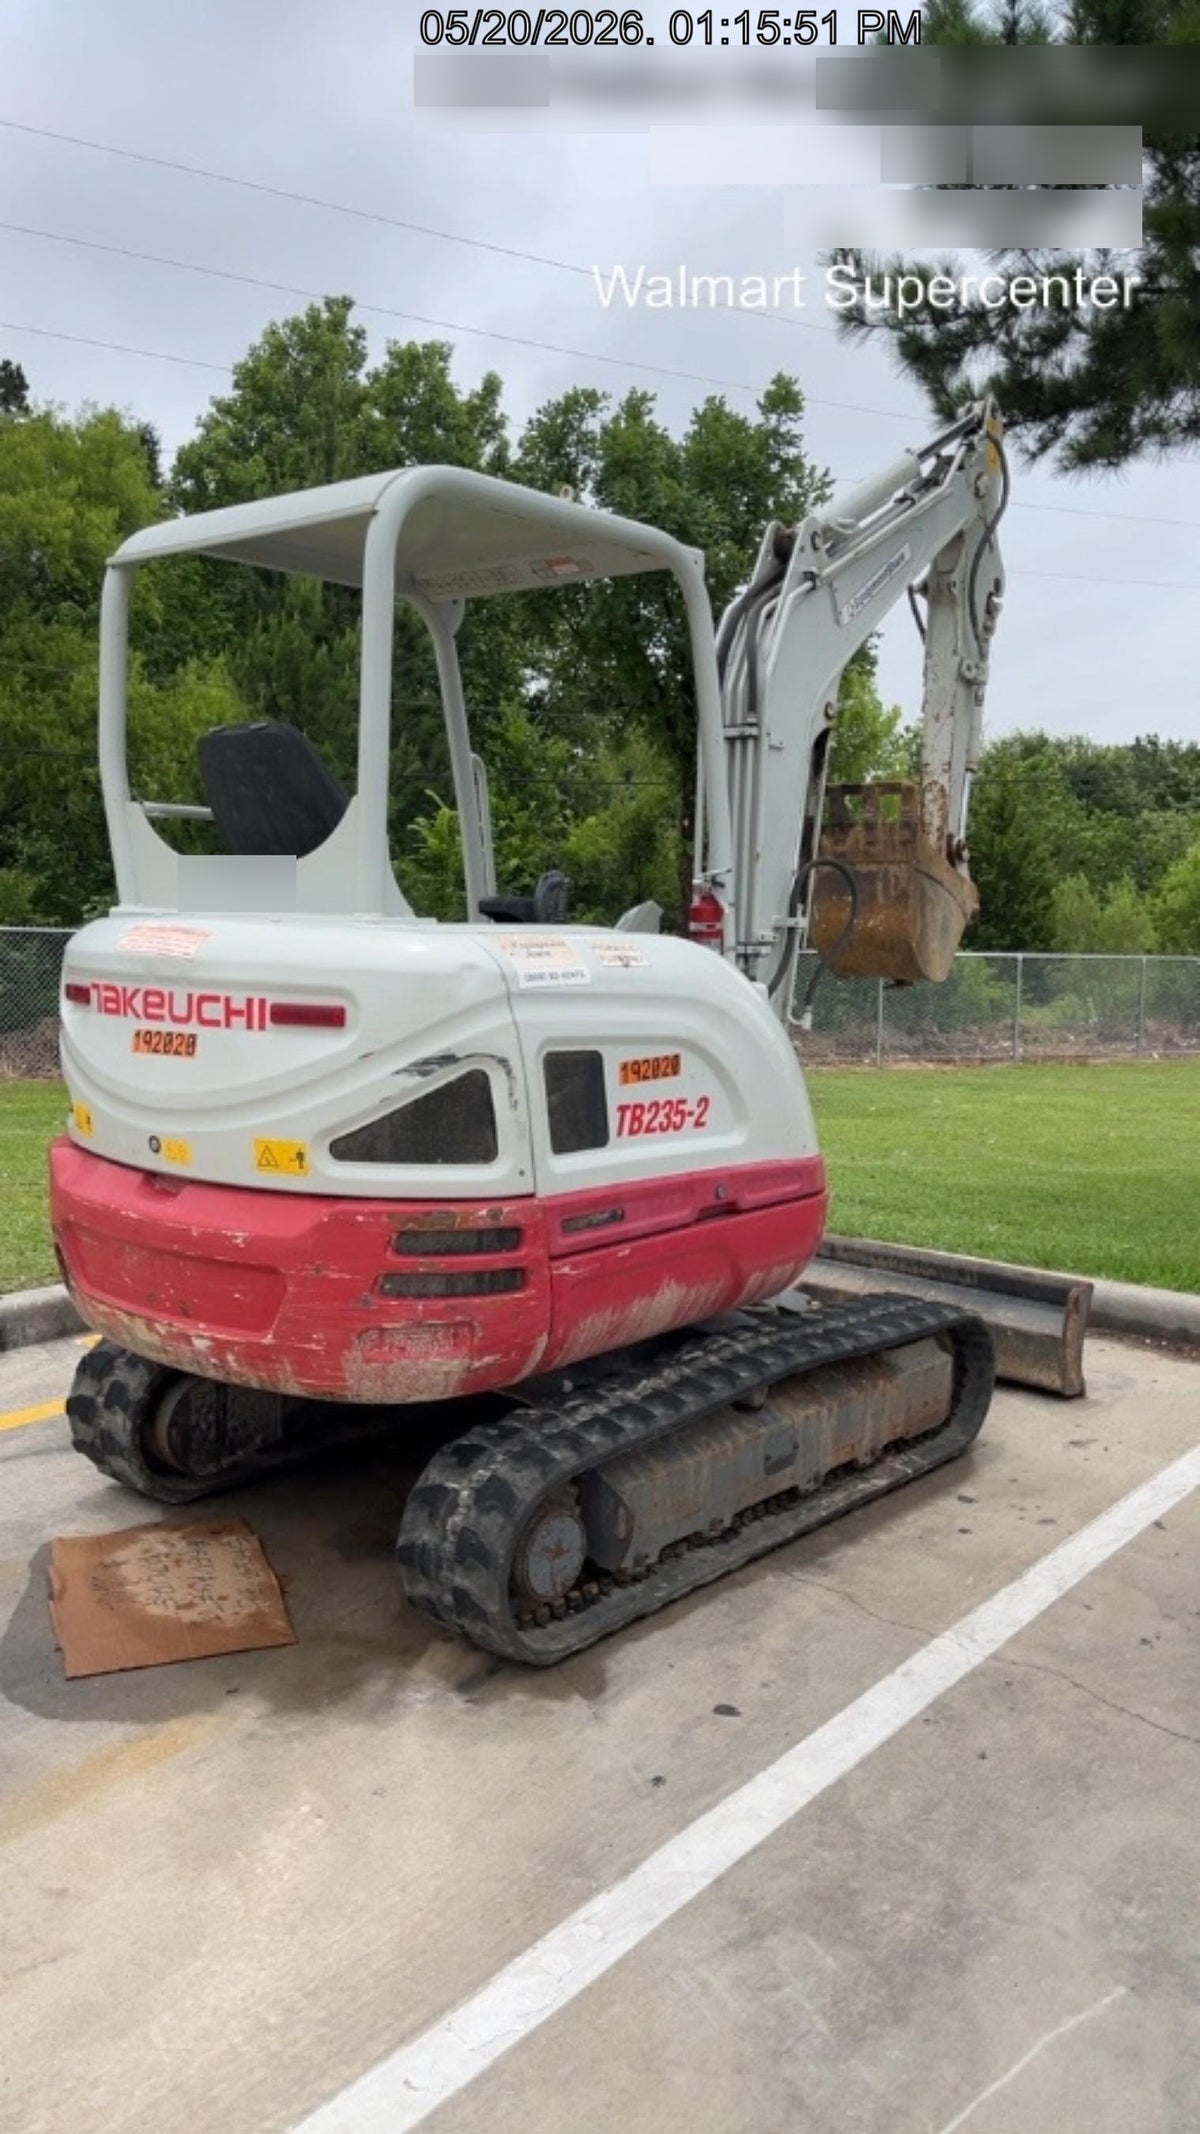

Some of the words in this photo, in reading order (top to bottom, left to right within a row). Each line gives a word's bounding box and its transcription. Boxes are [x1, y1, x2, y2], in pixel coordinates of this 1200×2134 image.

[132, 1030, 198, 1057] 192020
[620, 1054, 681, 1084] 192020
[616, 1094, 711, 1139] TB235-2
